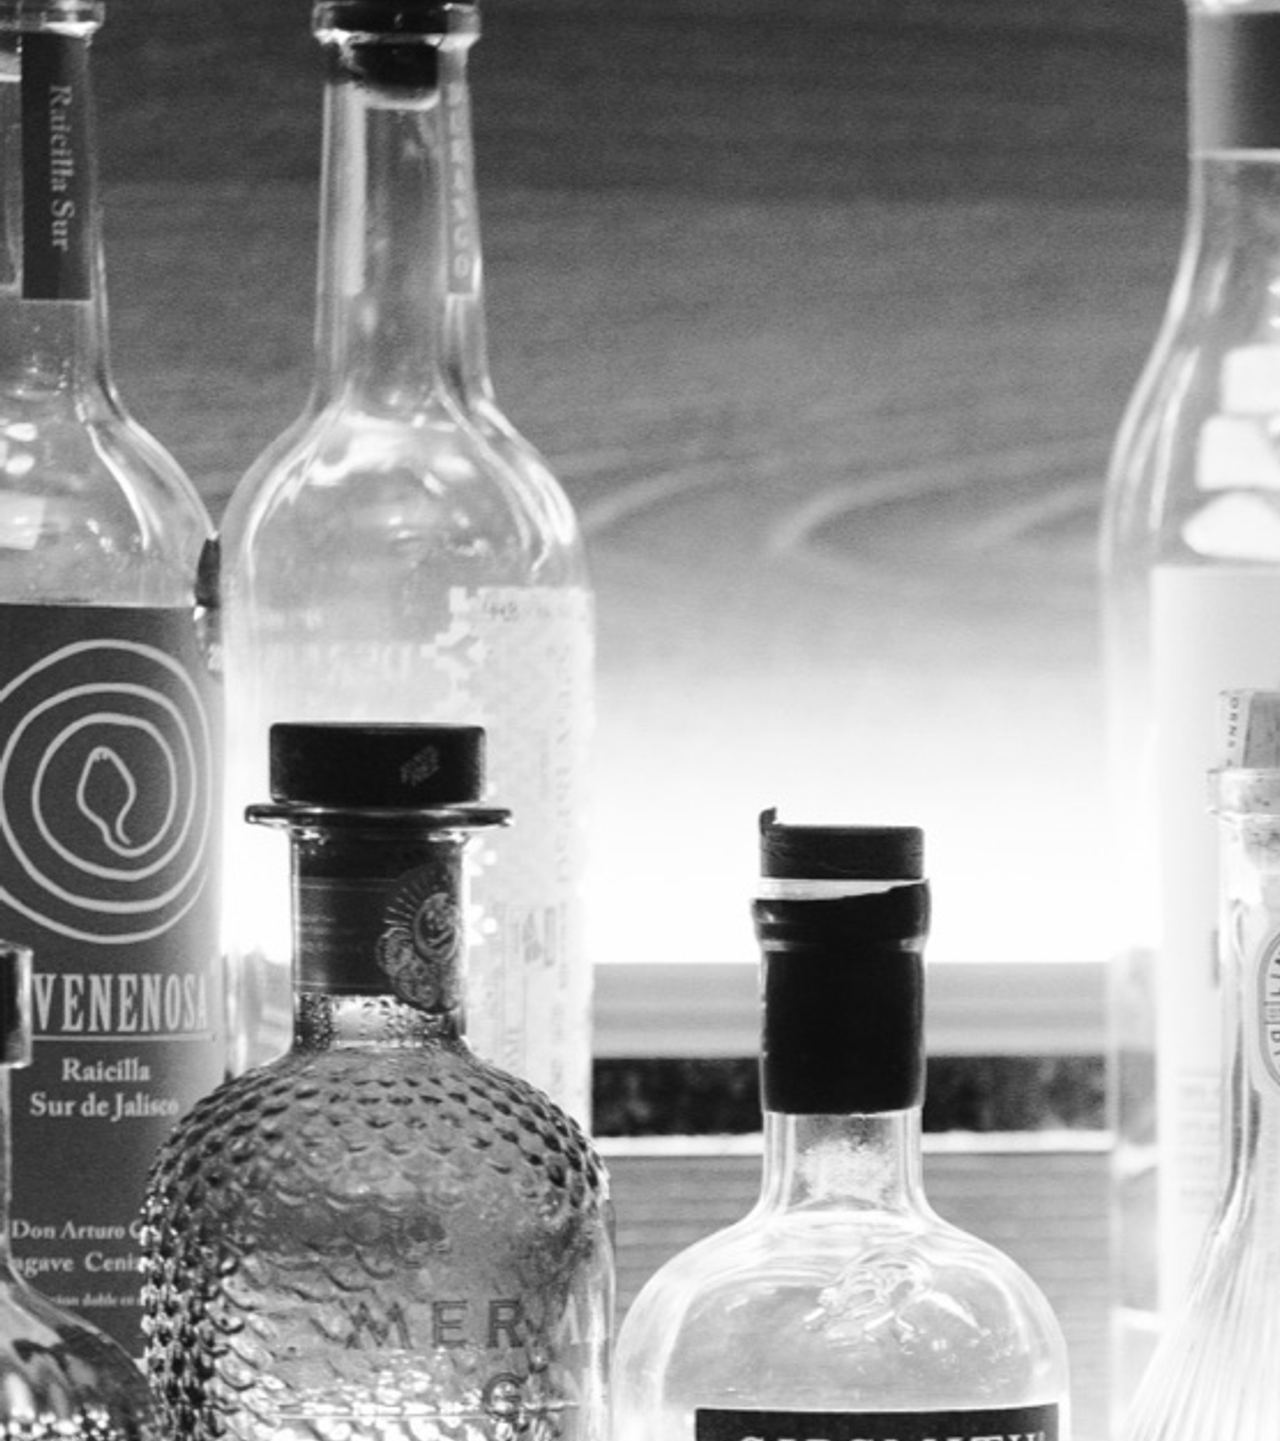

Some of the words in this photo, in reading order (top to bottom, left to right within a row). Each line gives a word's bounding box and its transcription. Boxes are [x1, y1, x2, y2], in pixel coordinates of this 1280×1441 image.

[48, 84, 76, 195] Raicilla
[50, 198, 76, 252] Sur
[31, 972, 209, 1033] VENENOSA
[61, 1056, 151, 1082] Raicilla
[29, 1090, 76, 1118] Sur
[80, 1092, 110, 1118] de
[109, 1092, 180, 1123] Jalisco
[11, 1219, 57, 1240] Don
[59, 1219, 126, 1240] Arturo
